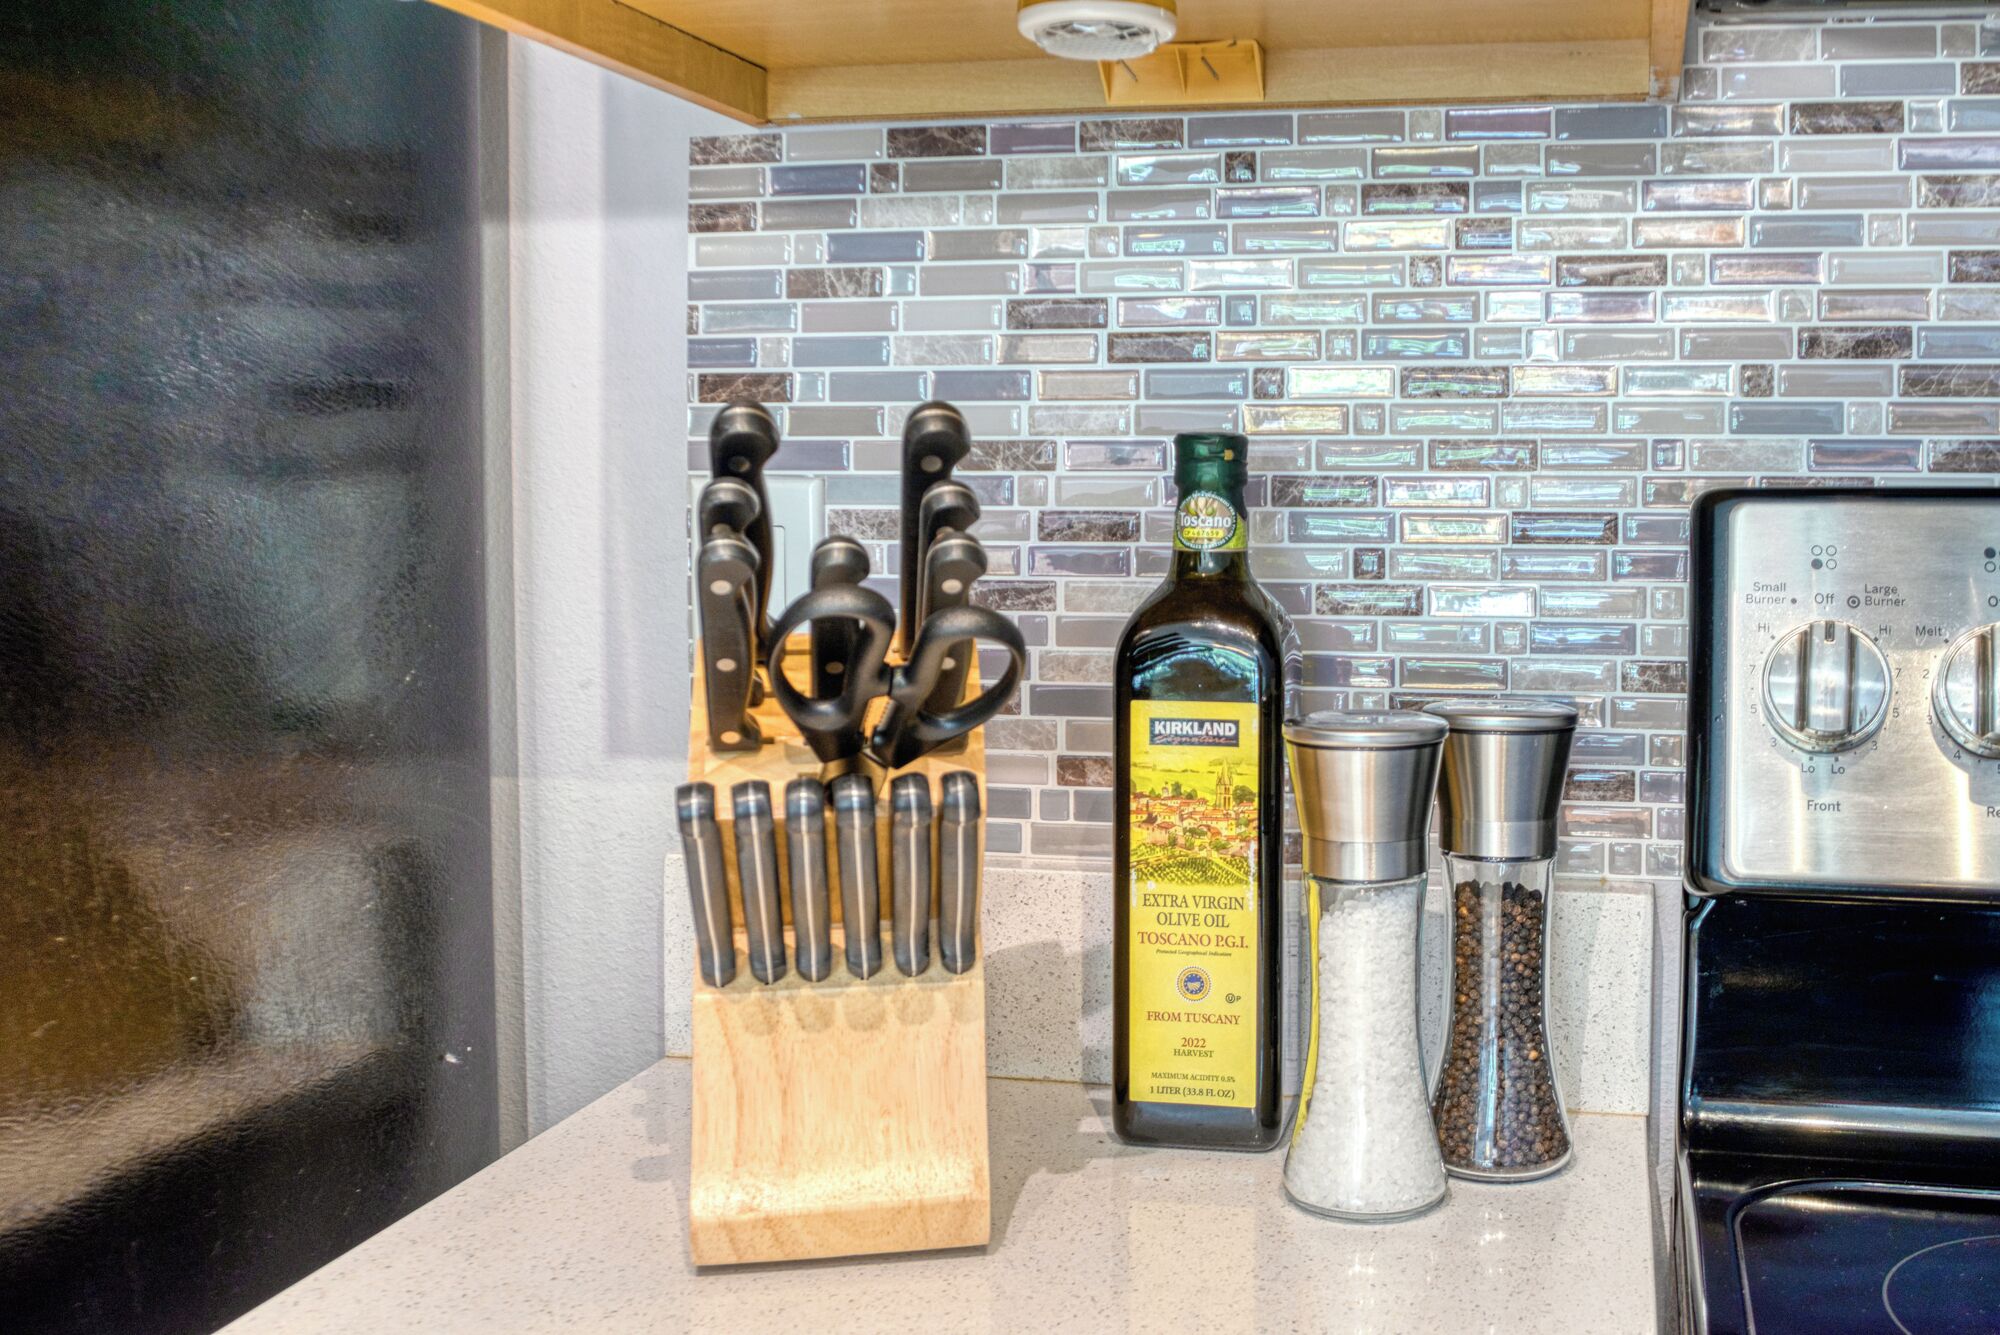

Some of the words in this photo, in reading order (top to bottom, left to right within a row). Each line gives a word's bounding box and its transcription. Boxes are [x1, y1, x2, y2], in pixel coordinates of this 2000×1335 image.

[1180, 512, 1231, 528] Toscano
[1753, 582, 1786, 592] Small
[1864, 584, 1898, 596] Large
[1746, 594, 1786, 604] Burner
[1814, 592, 1834, 604] Off
[1864, 596, 1906, 606] Burner
[1758, 623, 1770, 633] Hi
[1879, 624, 1892, 634] Hi
[1916, 625, 1942, 636] Melt
[1749, 665, 1756, 674] 7
[1896, 668, 1902, 678] 7
[1922, 670, 1930, 678] 2
[1750, 704, 1757, 714] 5
[1892, 708, 1900, 718] 5
[1926, 715, 1932, 724] 3
[1154, 721, 1236, 736] KIRKLAND
[1770, 738, 1776, 747] 3
[1872, 740, 1878, 750] 3
[1954, 750, 1962, 760] 4
[1802, 764, 1815, 774] Lo
[1831, 764, 1845, 774] Lo
[1807, 800, 1840, 812] Front
[1142, 894, 1188, 908] EXTRA
[1192, 896, 1244, 910] VIRGIN
[1156, 912, 1200, 927] OLIVE
[1204, 914, 1230, 928] OIL
[1137, 932, 1210, 946] TOSCANO
[1216, 934, 1248, 948] P.G.I.
[1146, 1011, 1180, 1022] FROM
[1184, 1012, 1240, 1025] TUSCANY
[1181, 1037, 1206, 1048] 2022
[1174, 1048, 1214, 1058] HARVEST
[1190, 1074, 1219, 1082] ACIDITY
[1150, 1086, 1154, 1094] 1
[1156, 1086, 1180, 1095] LITER
[1182, 1087, 1204, 1098] (33.8
